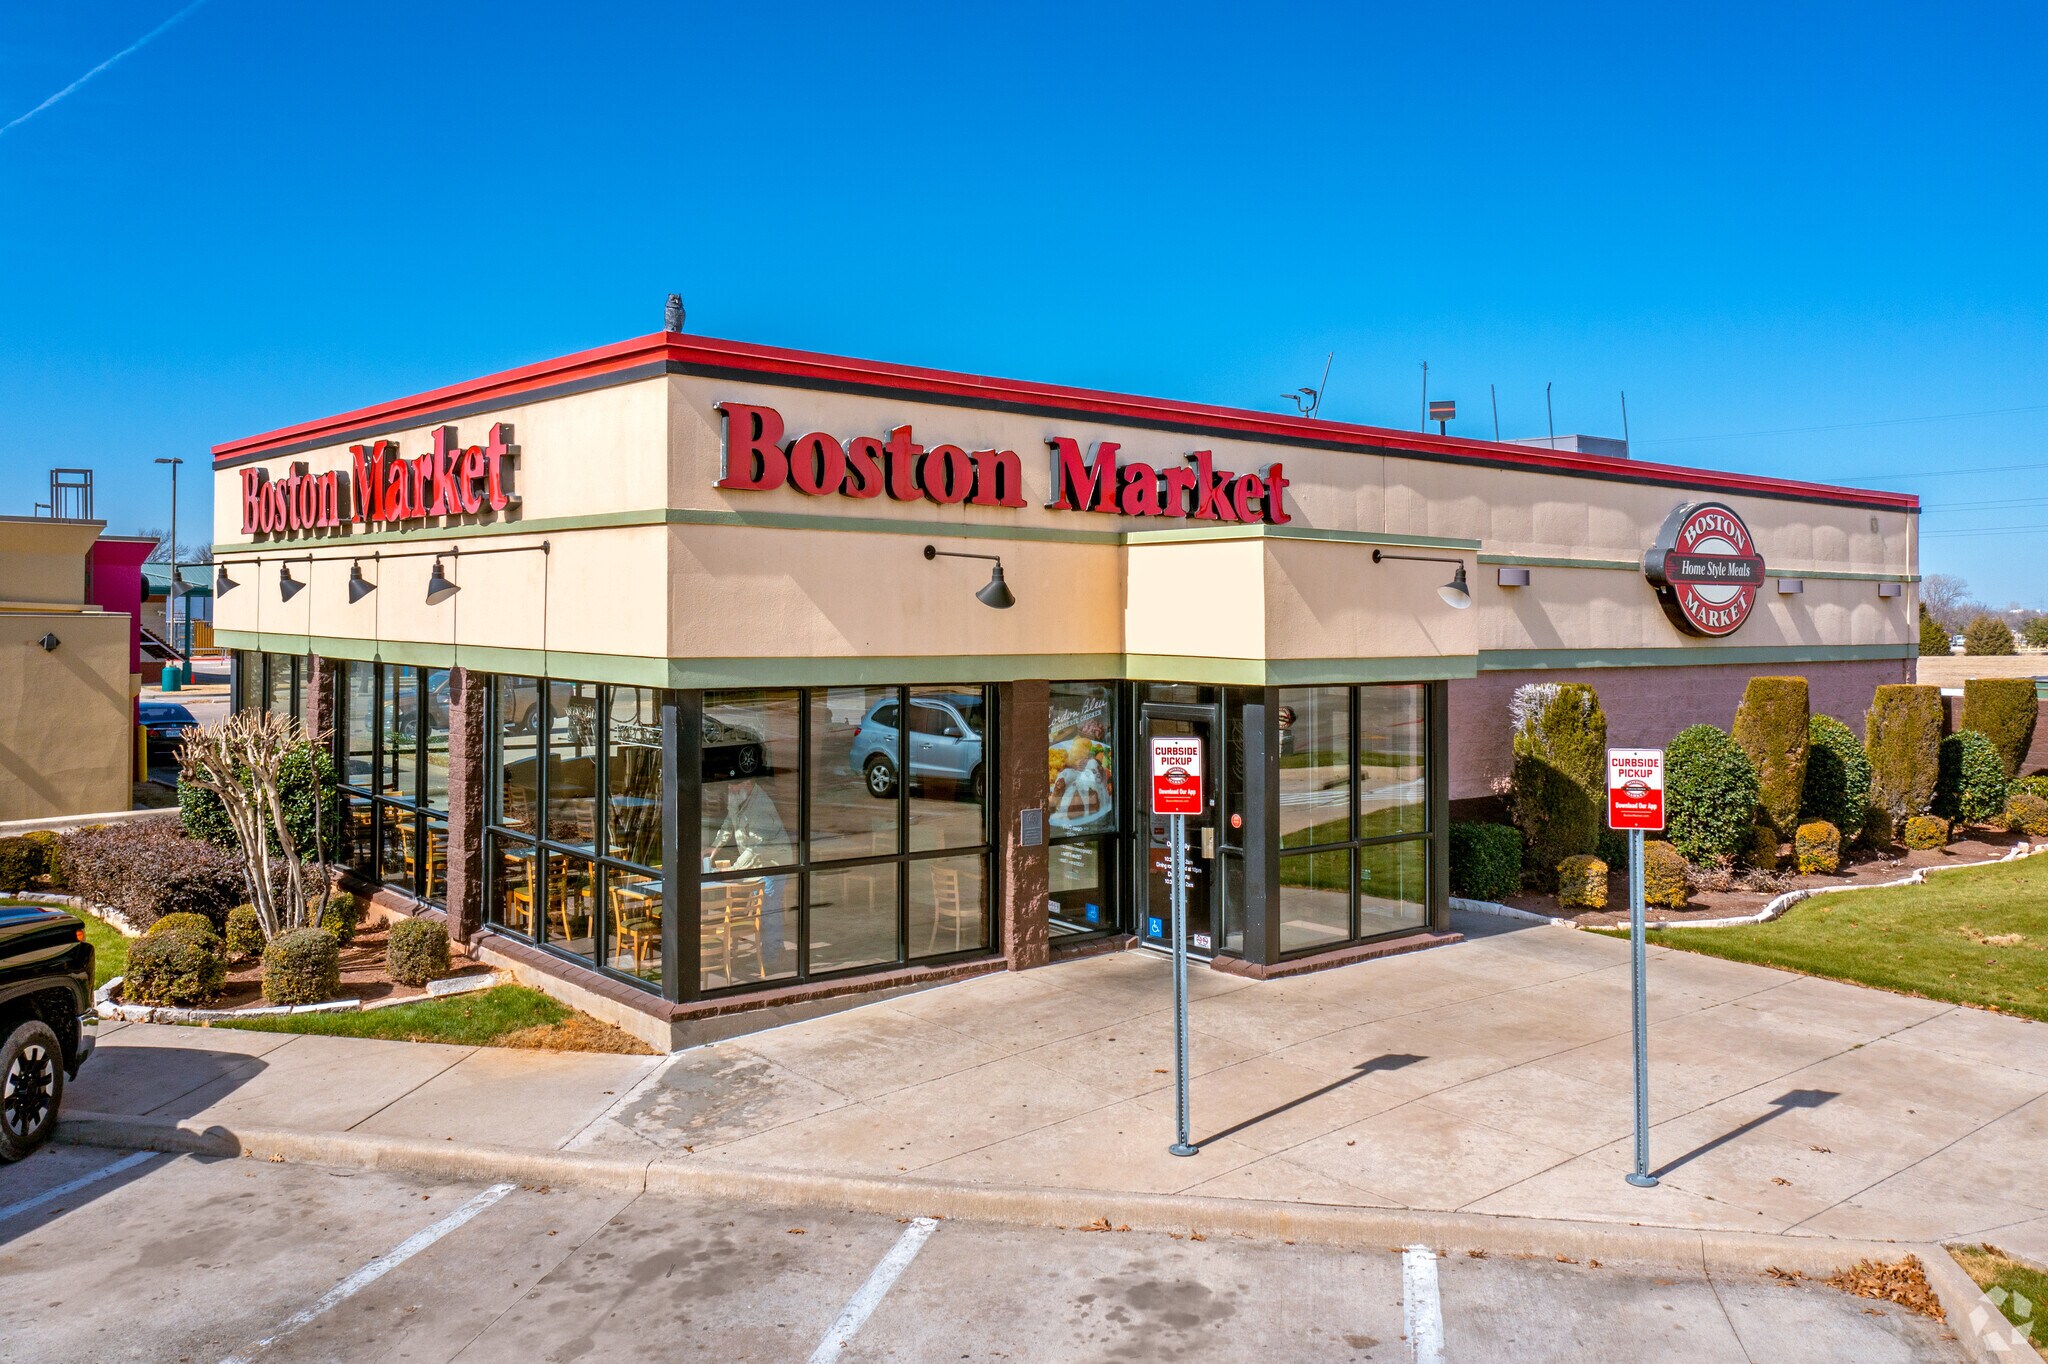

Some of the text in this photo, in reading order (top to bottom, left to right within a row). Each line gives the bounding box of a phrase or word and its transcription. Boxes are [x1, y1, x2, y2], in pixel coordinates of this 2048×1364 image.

[717, 401, 1292, 524] Boston Market
[239, 422, 510, 534] Boston Market
[1684, 514, 1746, 550] BOSTON
[1681, 560, 1751, 578] Home Style Meals
[1685, 590, 1747, 627] MARKET
[1155, 747, 1198, 756] CURBSIDE
[1161, 757, 1193, 765] PICKUP
[1611, 758, 1659, 768] CURBSIDE
[1618, 769, 1653, 778] PICKUP
[1188, 788, 1196, 796] App
[1647, 803, 1658, 811] App
